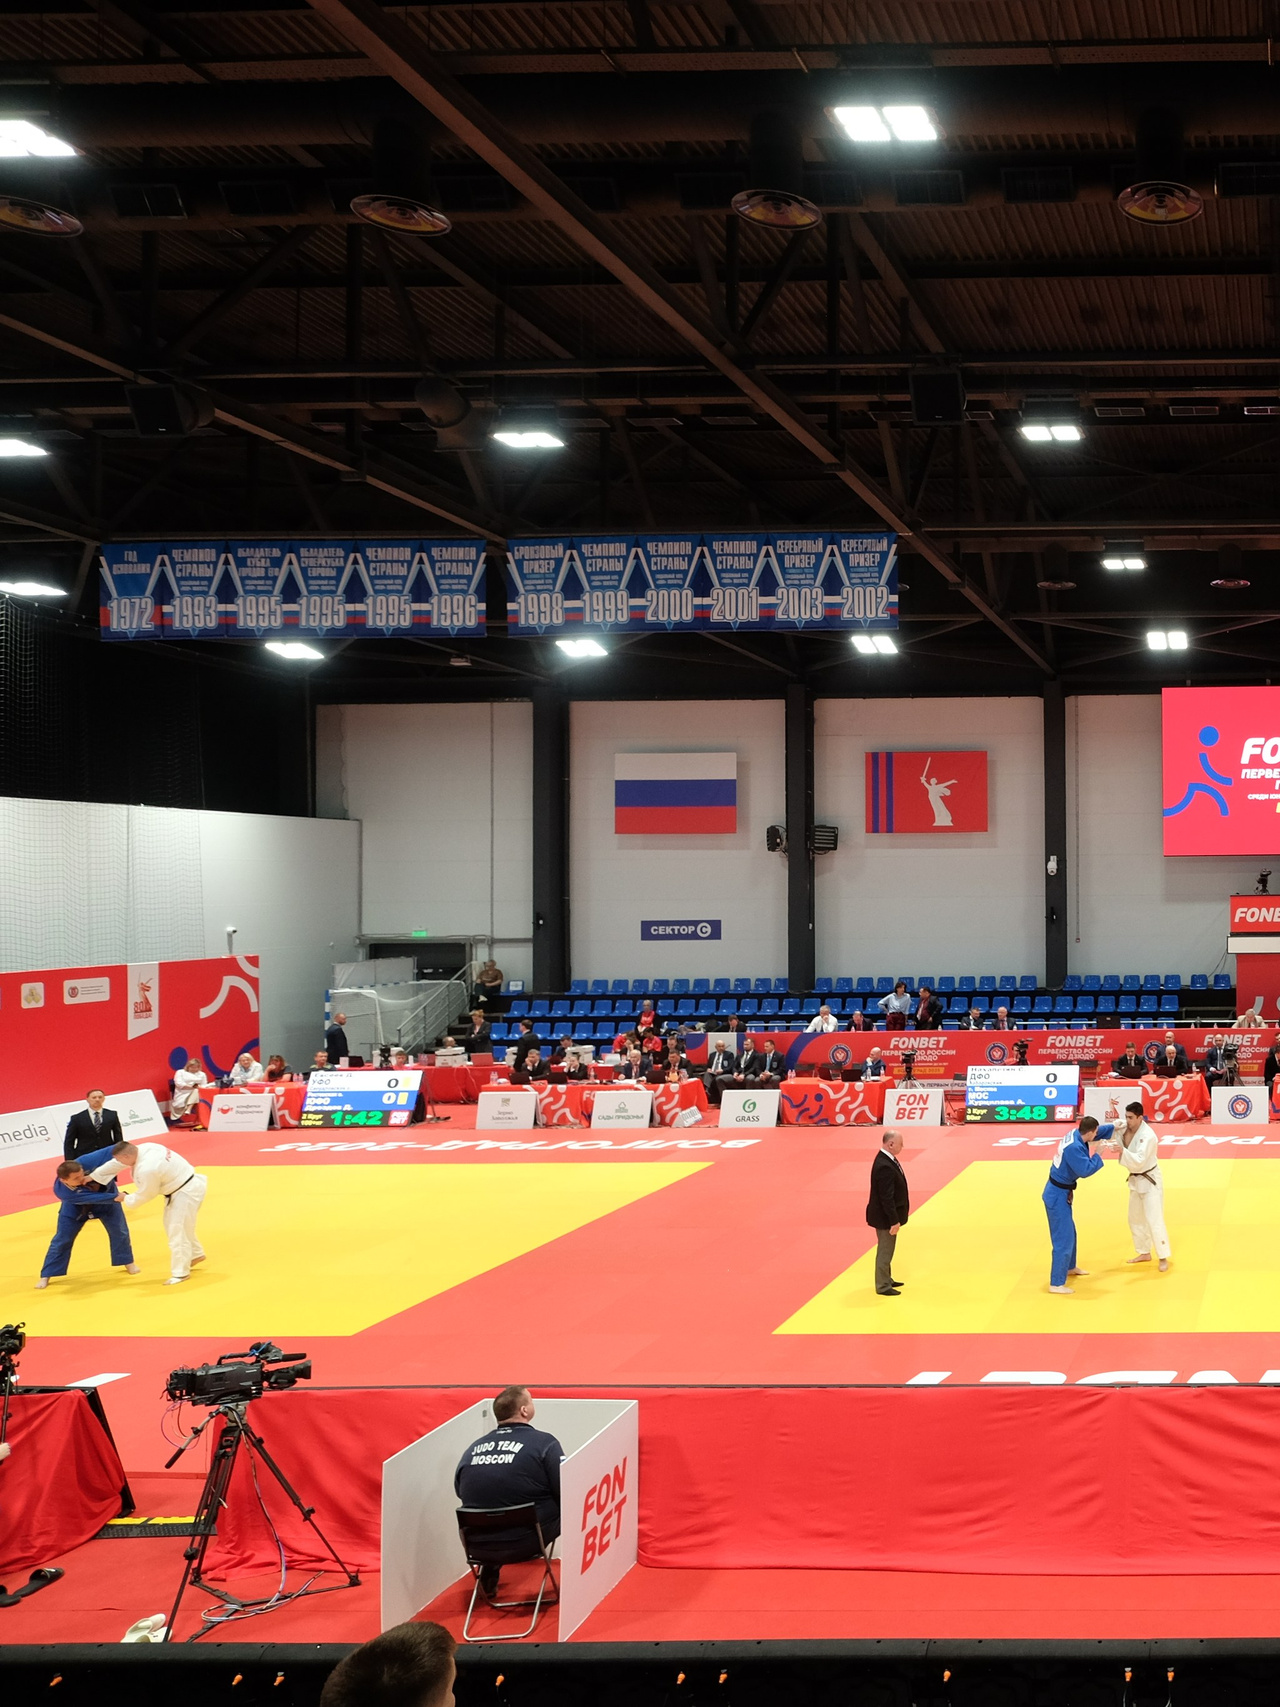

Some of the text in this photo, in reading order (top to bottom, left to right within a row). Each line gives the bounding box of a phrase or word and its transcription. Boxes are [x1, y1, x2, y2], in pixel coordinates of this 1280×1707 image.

[514, 542, 563, 560] БРОНЗОВЫЙ
[582, 542, 627, 557] ЧЕМПИОН
[647, 541, 692, 556] ЧЕМПИОН
[713, 540, 757, 555] ЧЕМПИОН
[776, 537, 824, 554] СЕРЕБРЯНЫЙ
[841, 536, 888, 553] СЕРЕБРЯНЫЙ
[172, 549, 216, 562] ЧЕМПИОН
[366, 547, 411, 561] ЧЕМПИОН
[431, 547, 476, 561] ЧЕМПИОН
[784, 554, 816, 568] ПРИЗЕР
[848, 553, 881, 567] ПРИЗЕР
[369, 562, 408, 576] СТРАНЫ
[435, 562, 473, 576] СТРАНЫ
[523, 559, 555, 574] ПРИЗЕР
[586, 558, 624, 573] СТРАНЫ
[651, 556, 688, 571] СТРАНЫ
[717, 555, 754, 569] СТРАНЫ
[176, 564, 213, 577] СТРАНЫ
[517, 592, 564, 625] 1998
[583, 590, 630, 623] 1999
[646, 588, 694, 622] 2000
[711, 587, 759, 620] 2001
[776, 586, 824, 620] 2003
[841, 585, 890, 620] 2002
[108, 597, 154, 630] 1972
[173, 596, 217, 629] 1993
[236, 596, 282, 629] 1995
[299, 595, 346, 628] 1995
[365, 595, 411, 627] 1995
[430, 595, 477, 627] 1996
[650, 925, 695, 935] СЕКТОР
[890, 1037, 947, 1048] FONBET
[1046, 1035, 1104, 1047] FONBET
[896, 1093, 929, 1105] FON
[331, 1111, 383, 1126] 1:42
[735, 1115, 760, 1123] GRASS
[895, 1108, 929, 1120] BET
[995, 1106, 1047, 1121] 3:48
[472, 1441, 524, 1456] JUDO TEAM
[470, 1453, 515, 1465] MOSCOW
[581, 1456, 628, 1532] FON
[580, 1495, 628, 1575] BET
